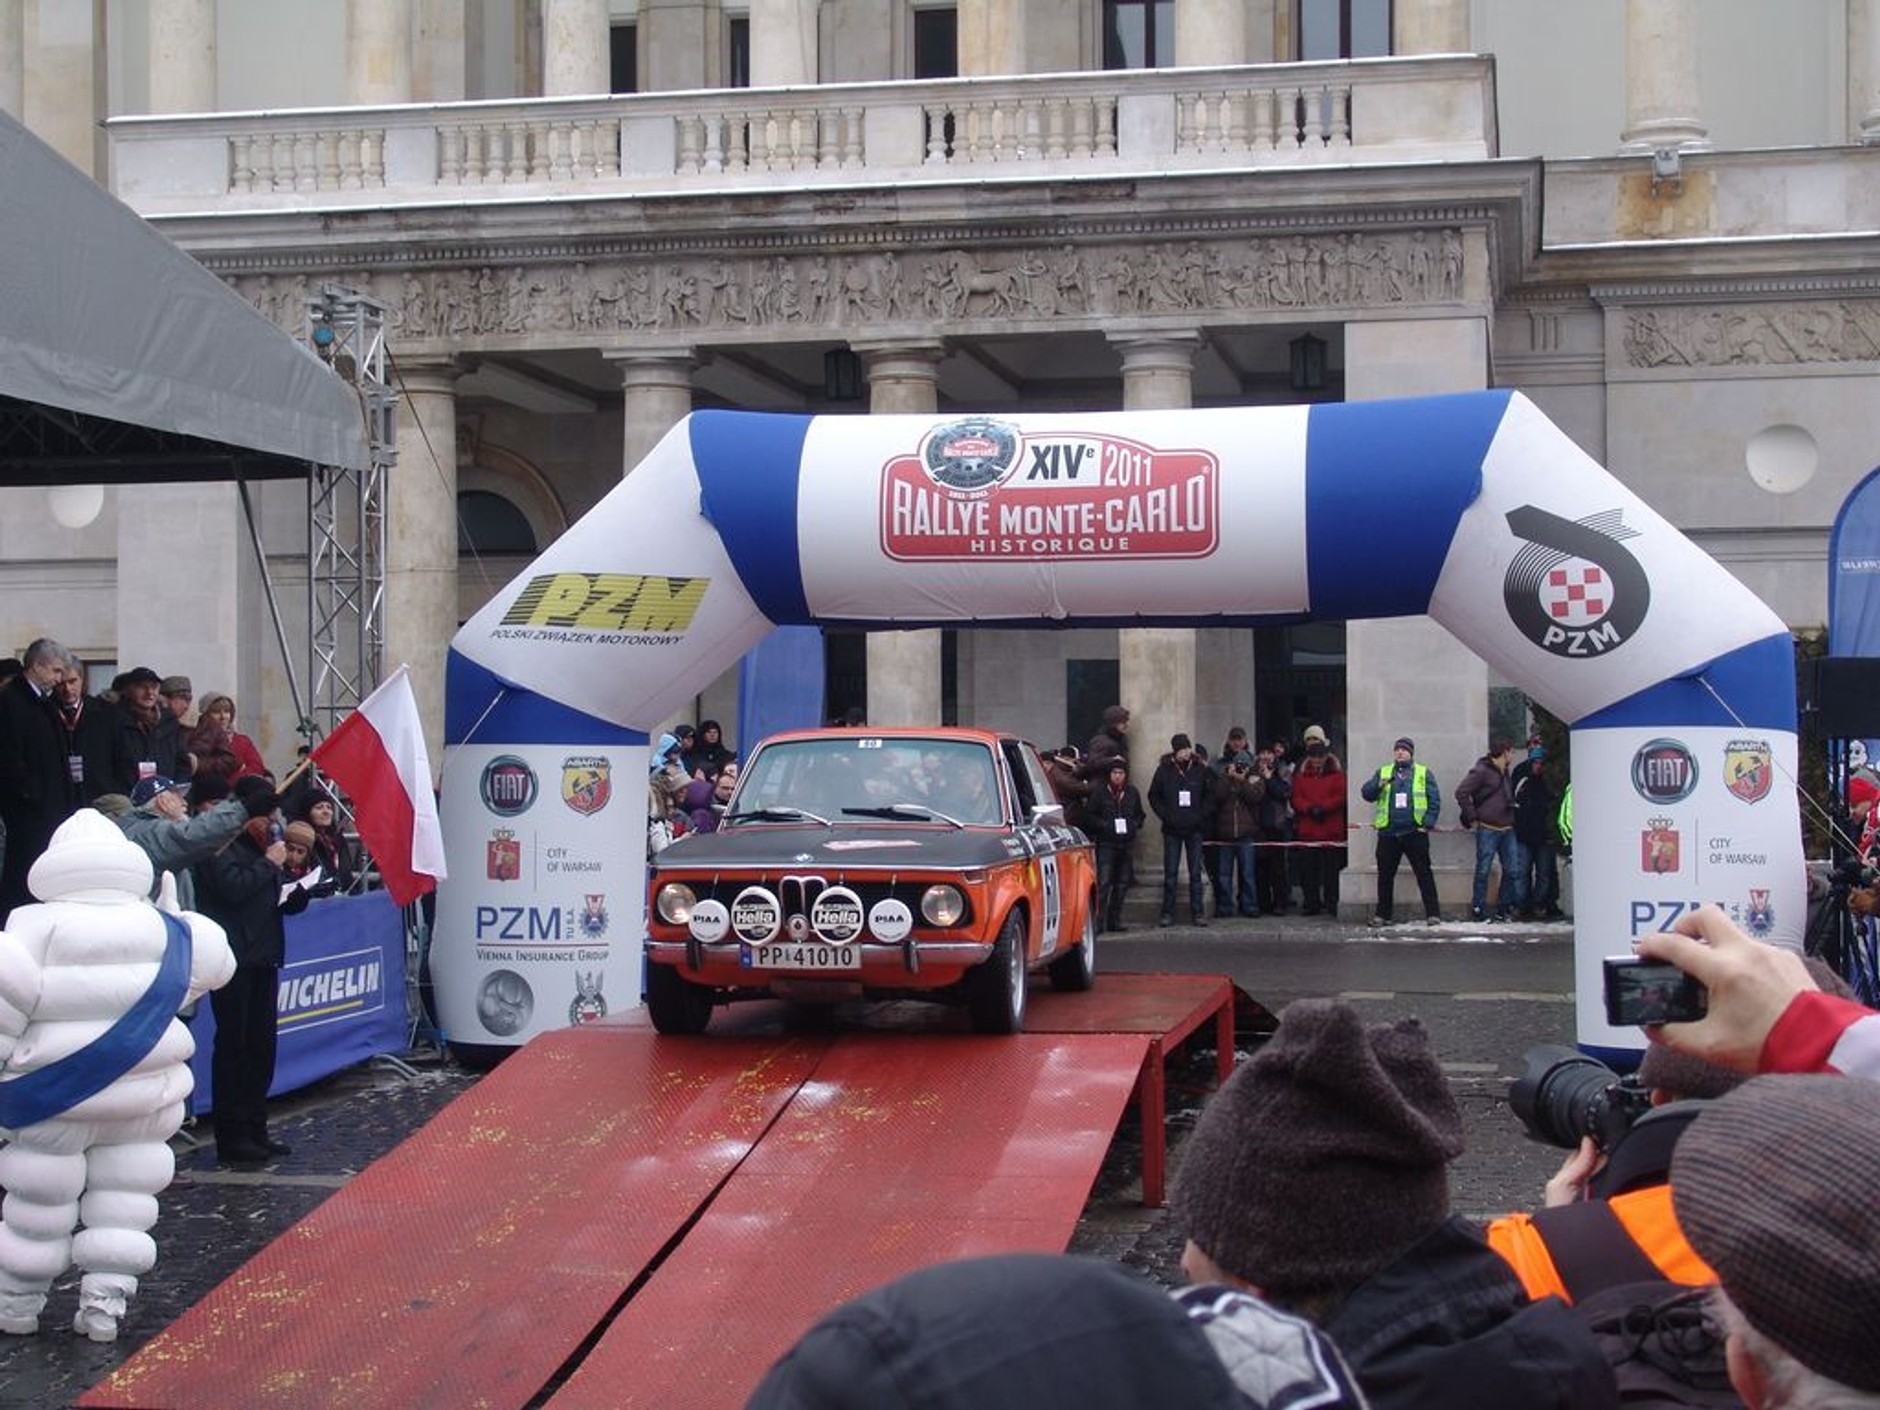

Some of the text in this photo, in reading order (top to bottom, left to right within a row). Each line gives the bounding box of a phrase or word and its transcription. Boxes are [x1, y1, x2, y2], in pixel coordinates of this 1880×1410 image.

[1104, 444, 1152, 487] 2011
[892, 474, 1207, 537] RALLYE MONTE-CARLO
[970, 536, 1130, 553] HISTORIQUE
[526, 572, 711, 631] PZM
[489, 629, 533, 640] POLSKI
[599, 634, 684, 646] MOTOROWY
[1542, 620, 1621, 655] PZM
[1648, 757, 1684, 788] FIAT
[493, 773, 526, 800] FIAT
[1709, 838, 1731, 850] CITY
[547, 848, 567, 859] CITY
[1709, 854, 1768, 865] OF WARSAW
[547, 862, 603, 873] OF WARSAW
[476, 906, 562, 940] PZM
[693, 915, 721, 924] PIAA
[736, 910, 775, 925] Hella
[817, 910, 859, 925] Hella
[874, 914, 905, 924] PIAA
[1630, 901, 1726, 936] PZ
[759, 946, 853, 966] PP 41010
